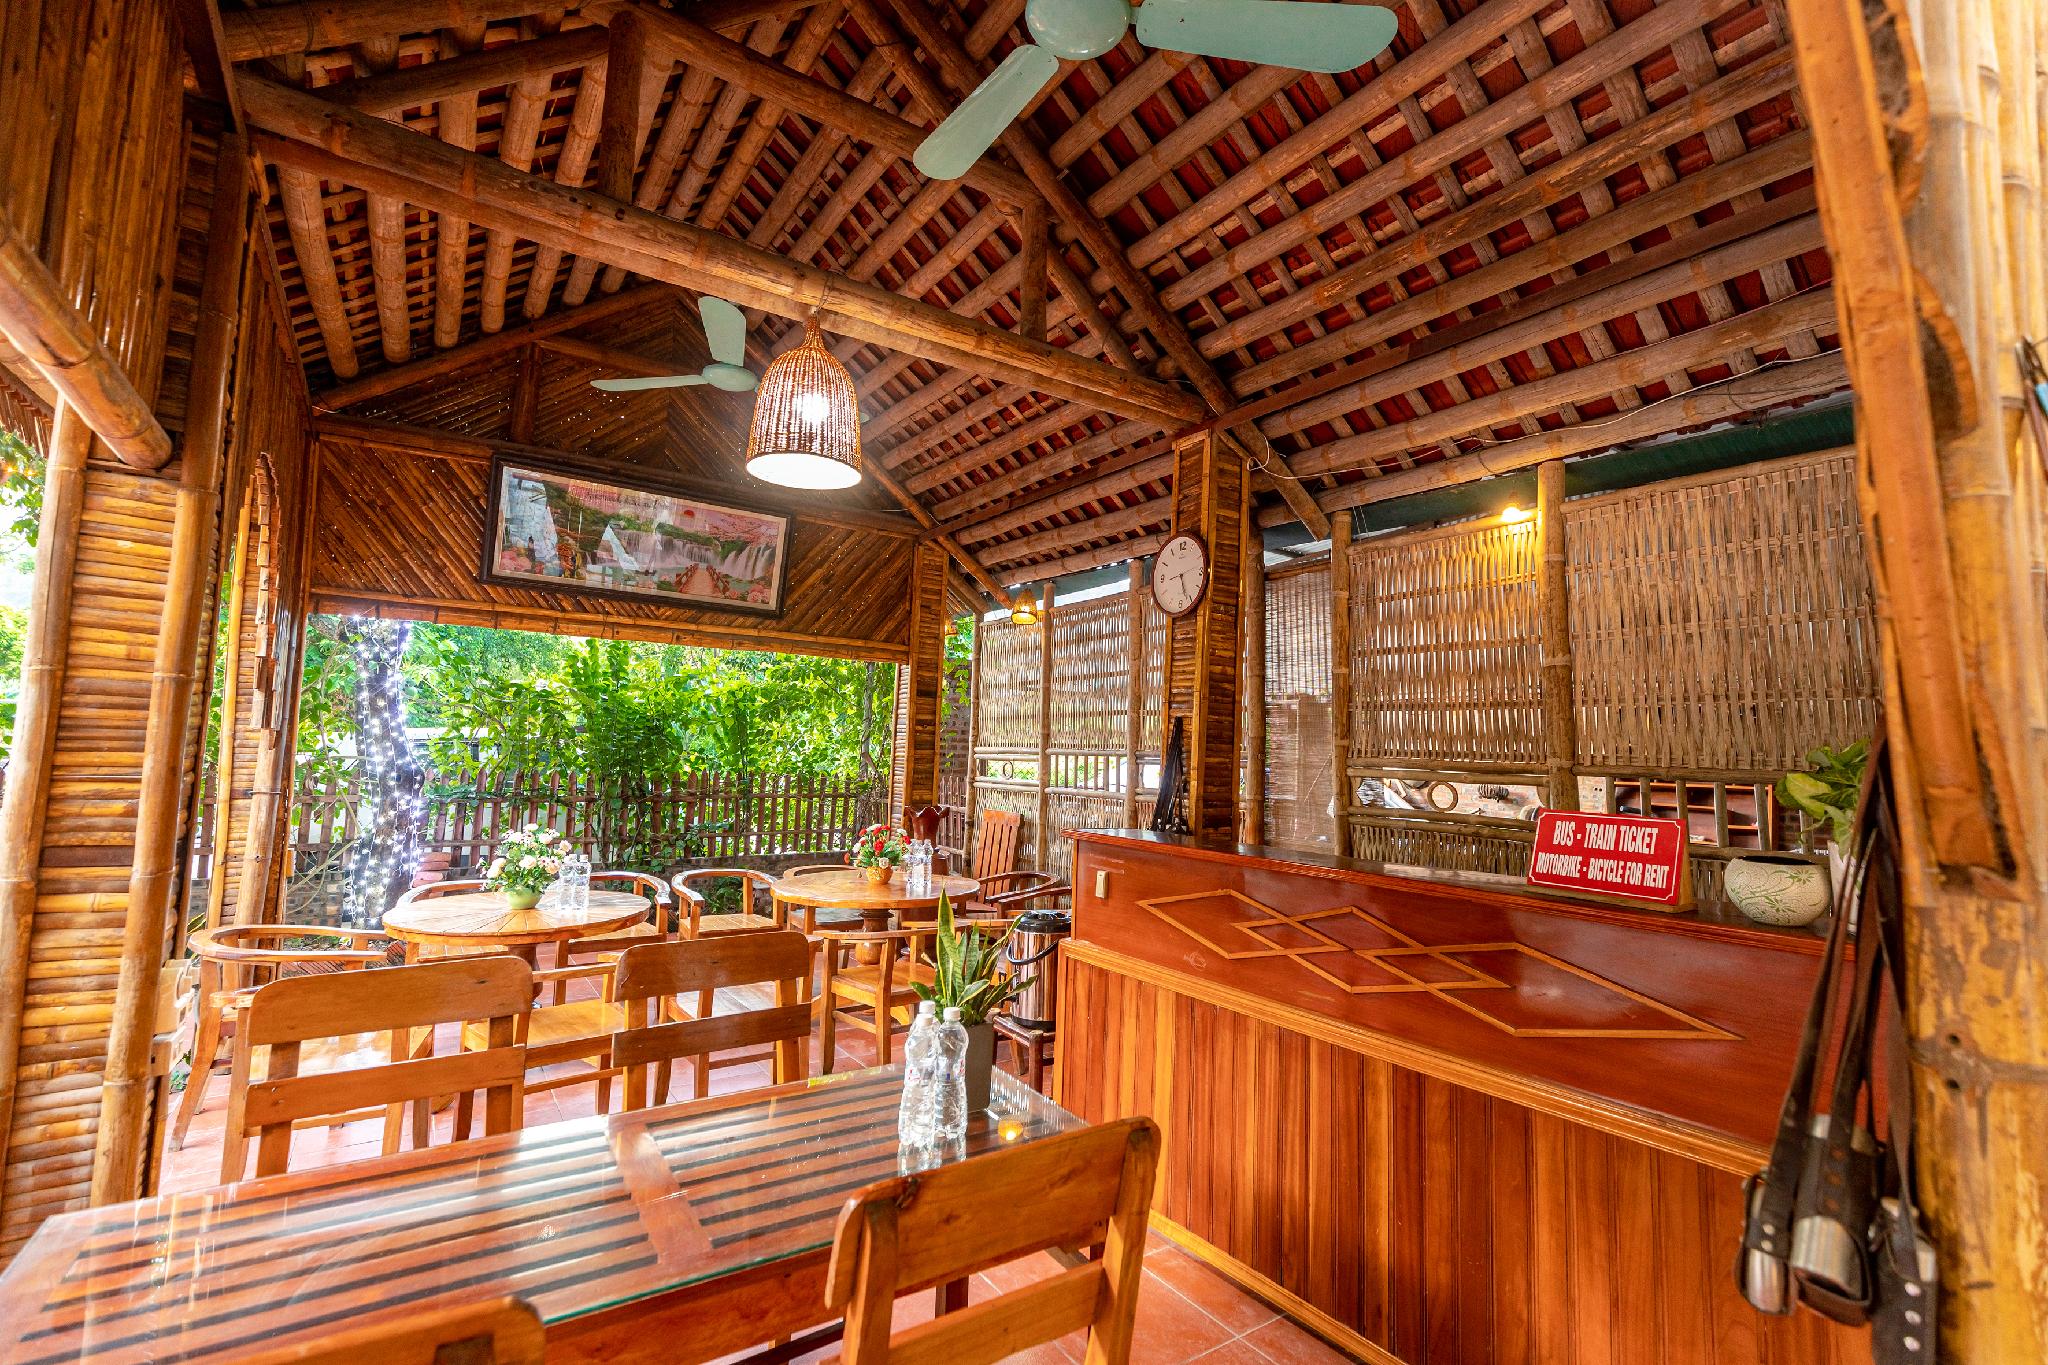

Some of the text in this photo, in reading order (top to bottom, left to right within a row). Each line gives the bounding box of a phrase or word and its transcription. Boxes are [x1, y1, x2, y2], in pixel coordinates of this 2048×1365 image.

[1179, 541, 1187, 551] 12
[1553, 820, 1575, 846] BUS
[1583, 823, 1617, 851] TRAIN
[1618, 825, 1659, 855] TICKET
[1535, 852, 1582, 878] MOTORBIKE
[1587, 858, 1624, 883] BICYCLE
[1624, 861, 1643, 886] FOR
[1644, 864, 1669, 889] RENT
